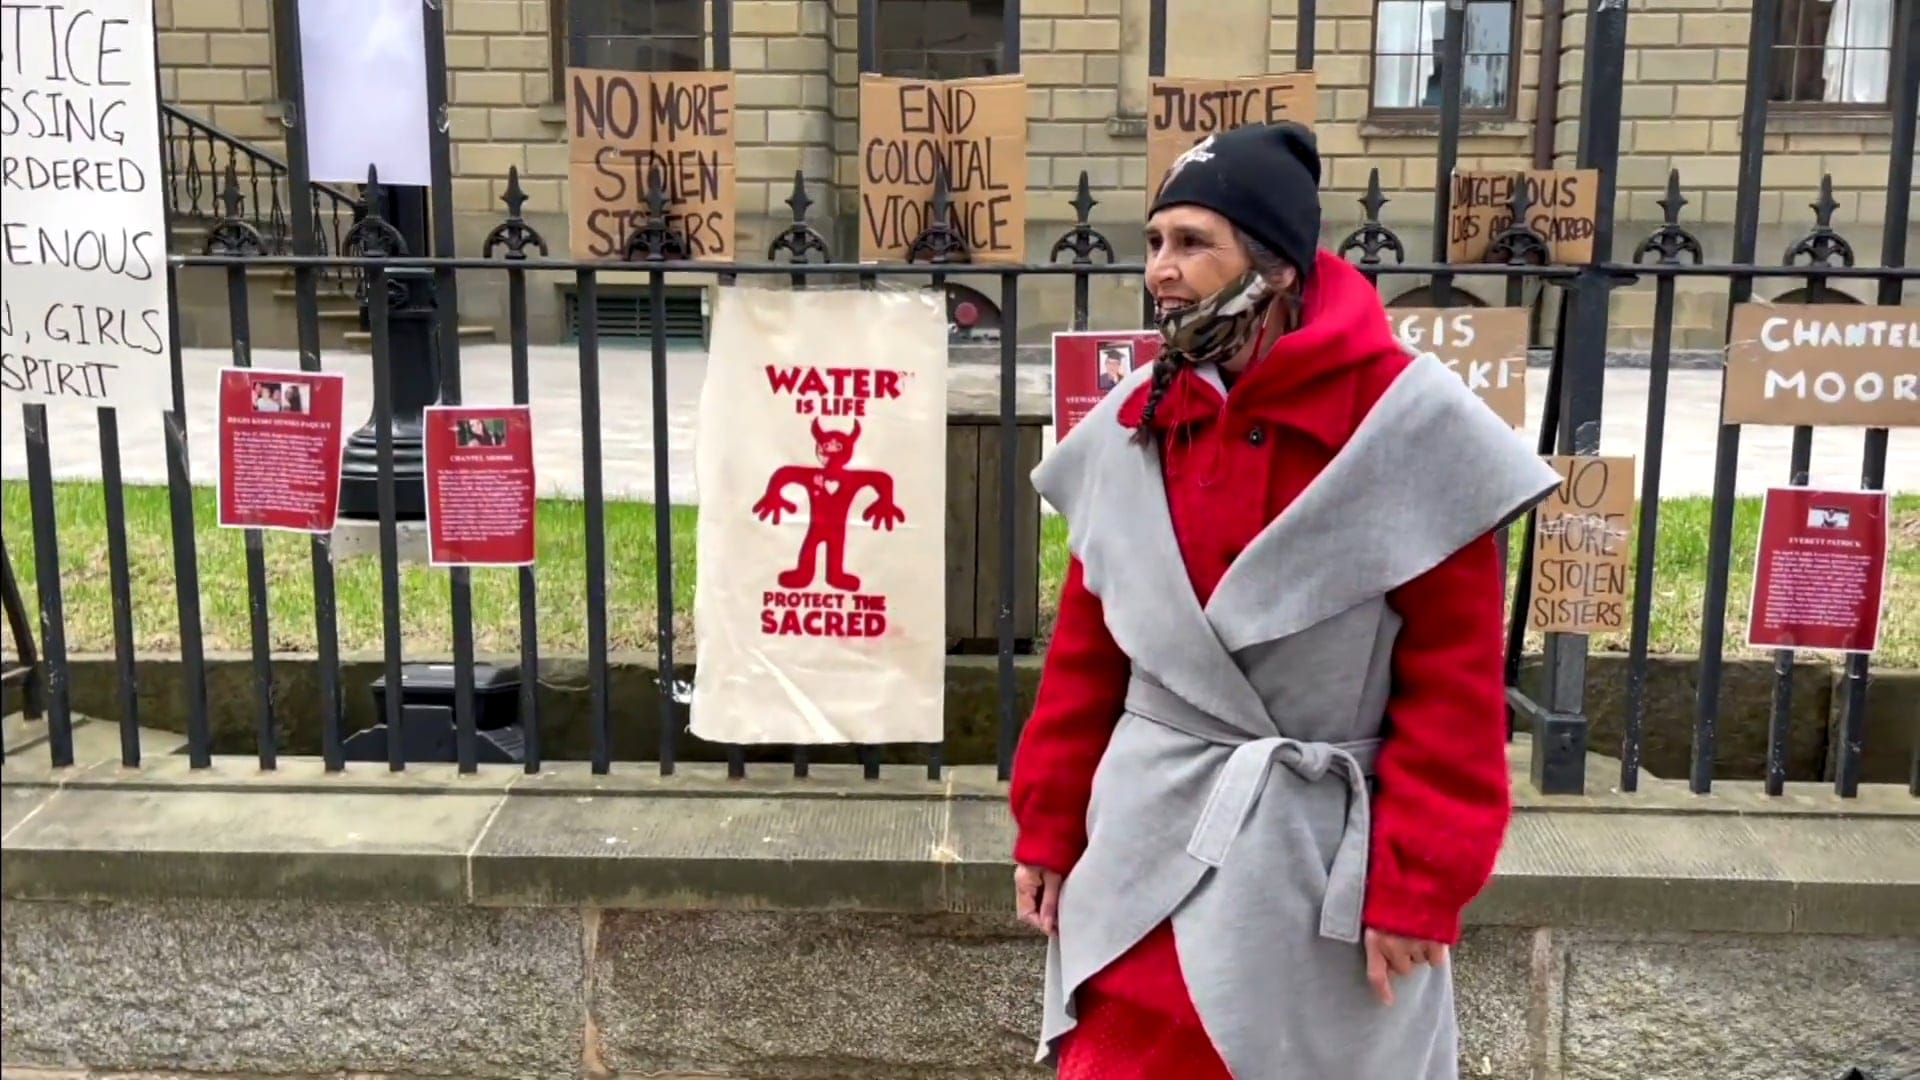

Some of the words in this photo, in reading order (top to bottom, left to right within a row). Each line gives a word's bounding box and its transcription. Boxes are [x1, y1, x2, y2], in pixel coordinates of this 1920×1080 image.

[1, 6, 131, 86] TICE
[574, 75, 639, 139] NO
[651, 82, 728, 142] MORE
[900, 85, 976, 134] END
[1153, 83, 1294, 131] JUSTICE
[3, 156, 145, 192] RDERED
[594, 146, 718, 204] STOLEN
[866, 137, 1008, 192] COLONIAL
[587, 209, 724, 256] SISERS
[863, 195, 1012, 249] VIOLNCE
[4, 223, 153, 281] ENOUS
[45, 303, 163, 354] GIRLS
[1386, 315, 1475, 347] GIS
[1761, 317, 1920, 352] CHANTEL
[1, 353, 119, 398] SPIRIT
[766, 364, 901, 400] WATER
[1764, 369, 1918, 403] MOOR
[796, 399, 814, 414] IS
[821, 398, 865, 416] LIFE
[1540, 512, 1624, 557] MORE
[1538, 559, 1625, 597] STOLEN
[760, 609, 886, 637] SACRED
[763, 592, 845, 608] PROTECT
[852, 595, 886, 611] THE
[1534, 598, 1622, 627] SISTERS
